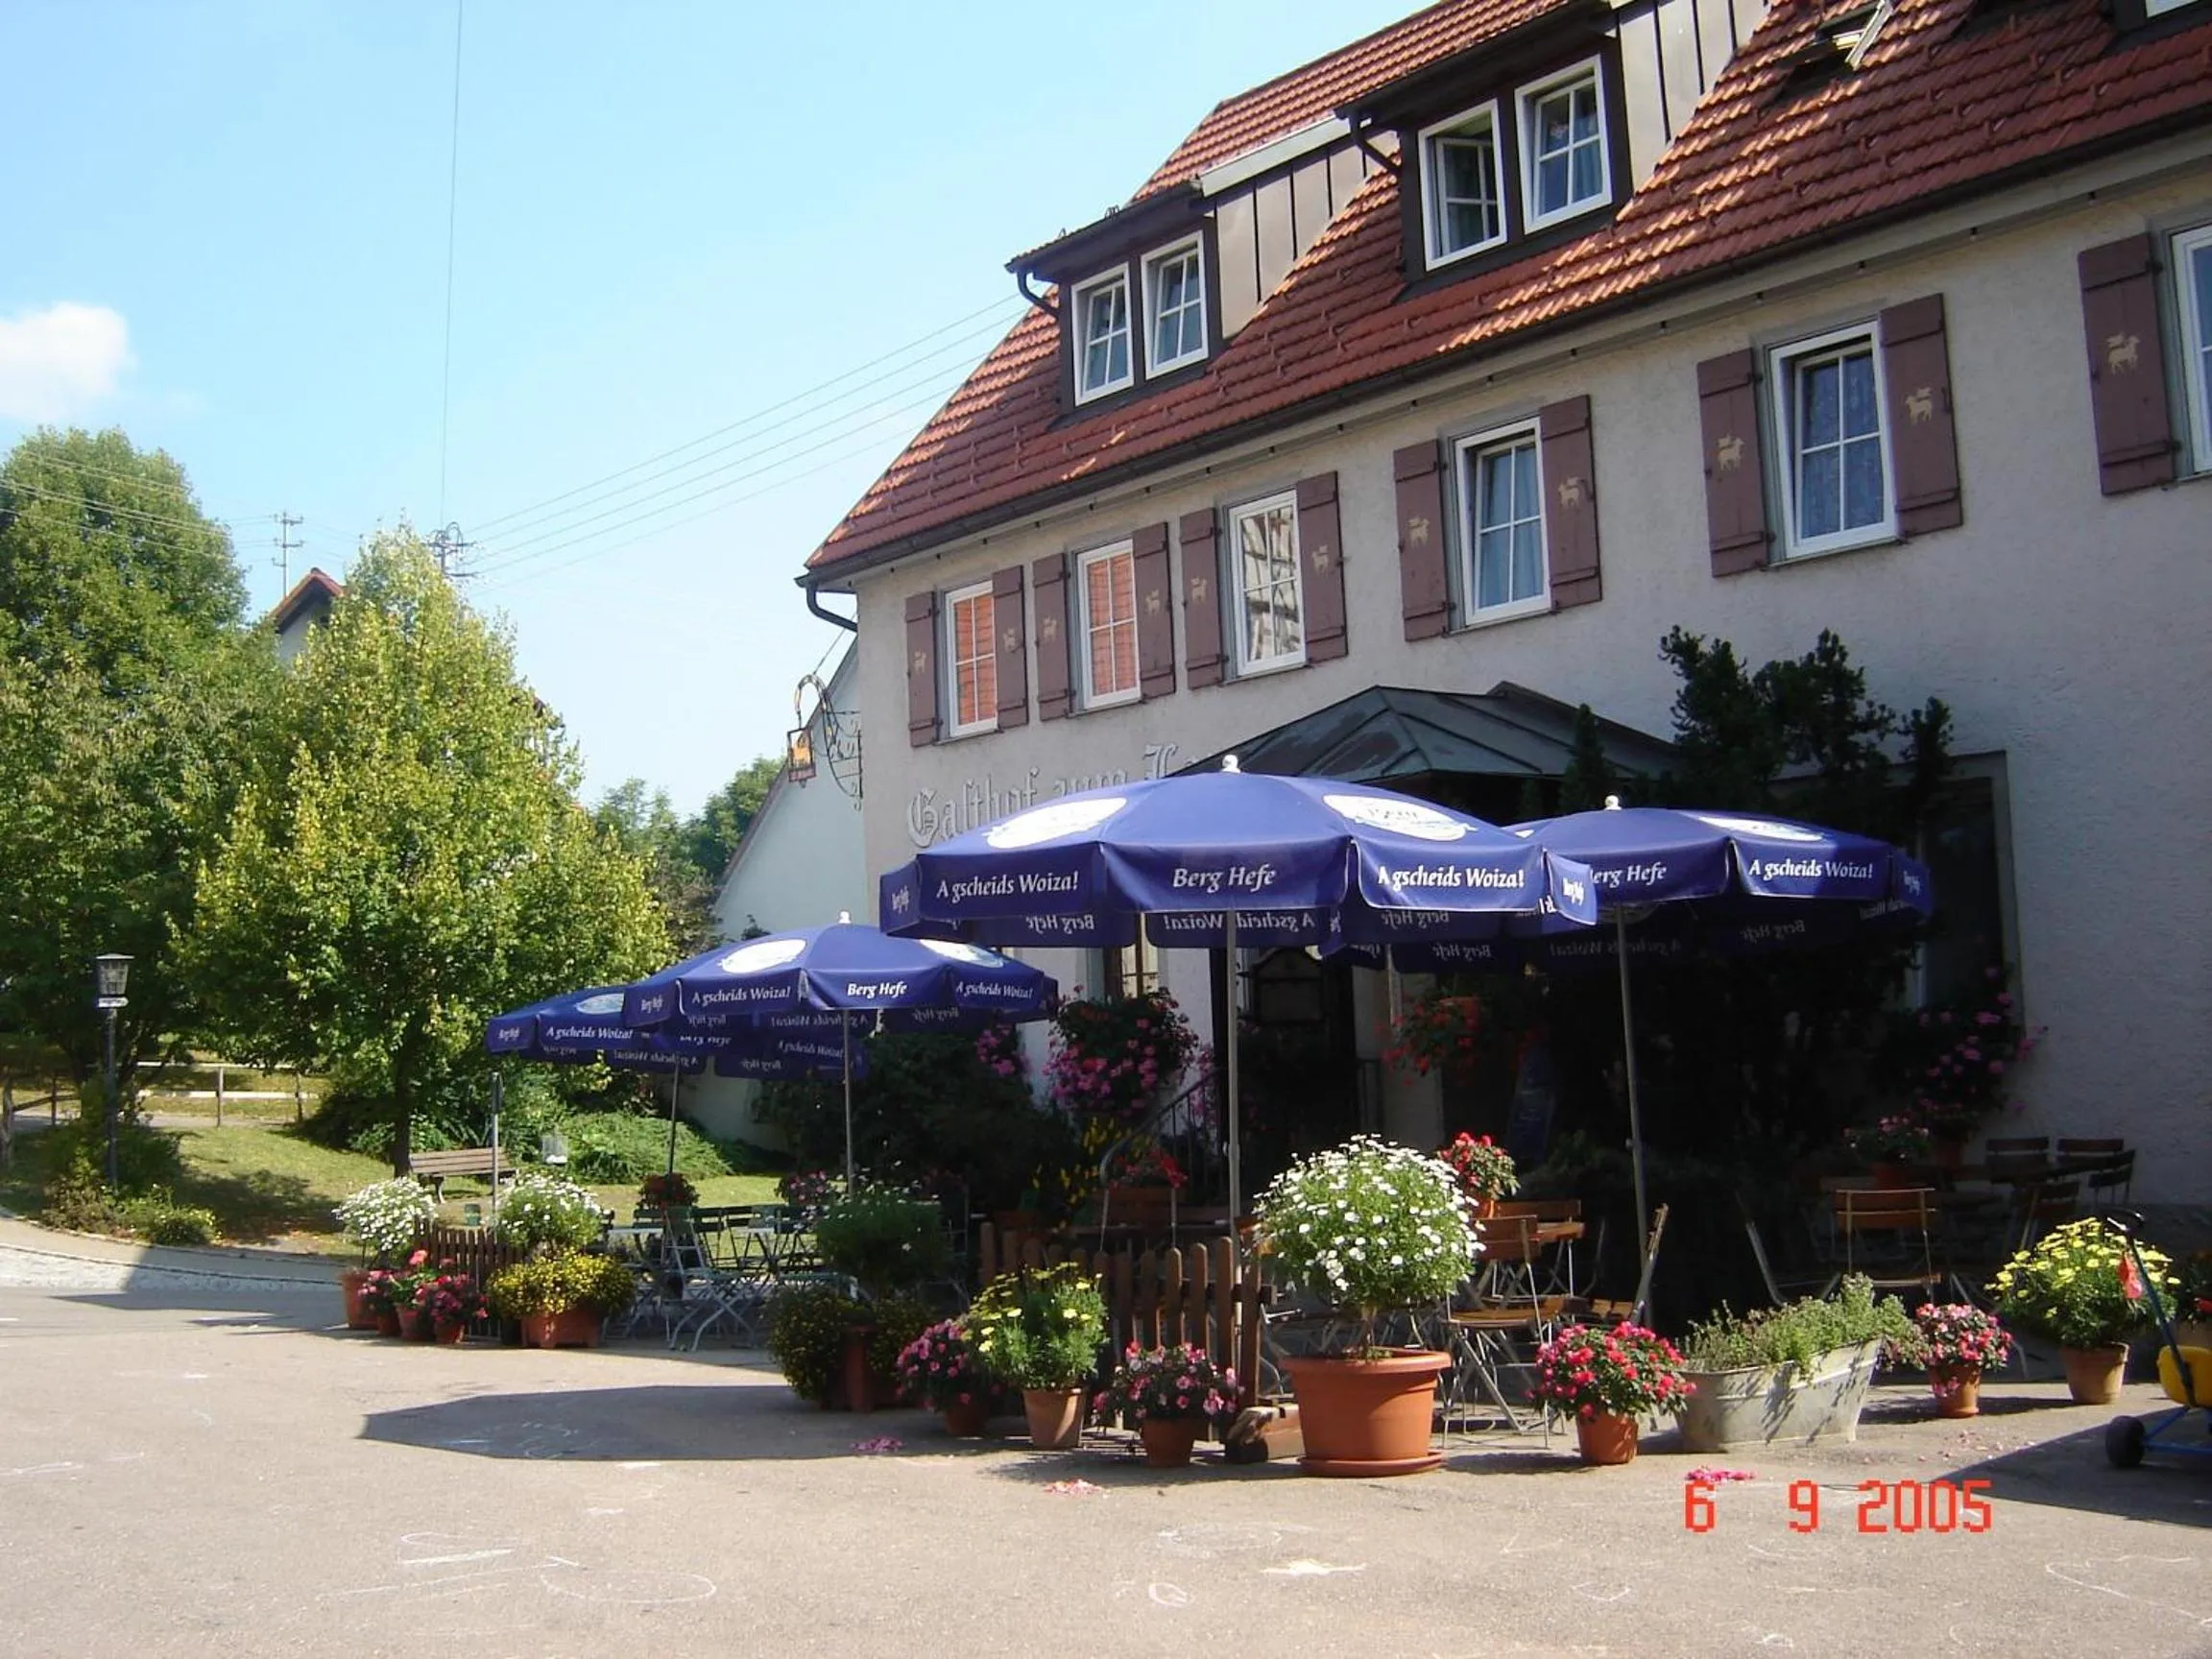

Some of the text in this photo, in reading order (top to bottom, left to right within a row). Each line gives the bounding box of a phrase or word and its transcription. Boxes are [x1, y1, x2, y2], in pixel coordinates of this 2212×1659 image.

[1171, 862, 1277, 894] Berg Hefe
[1378, 864, 1525, 892] A gscheids Woiza!
[1590, 861, 1668, 889] erg Hefe
[1749, 857, 1873, 881] A gscheids Woiza!
[935, 879, 950, 900] A
[951, 873, 1015, 904] gscheids
[1018, 870, 1079, 894] Woiza!
[702, 988, 748, 1008] gscheids
[847, 980, 908, 999] Berg Hefe
